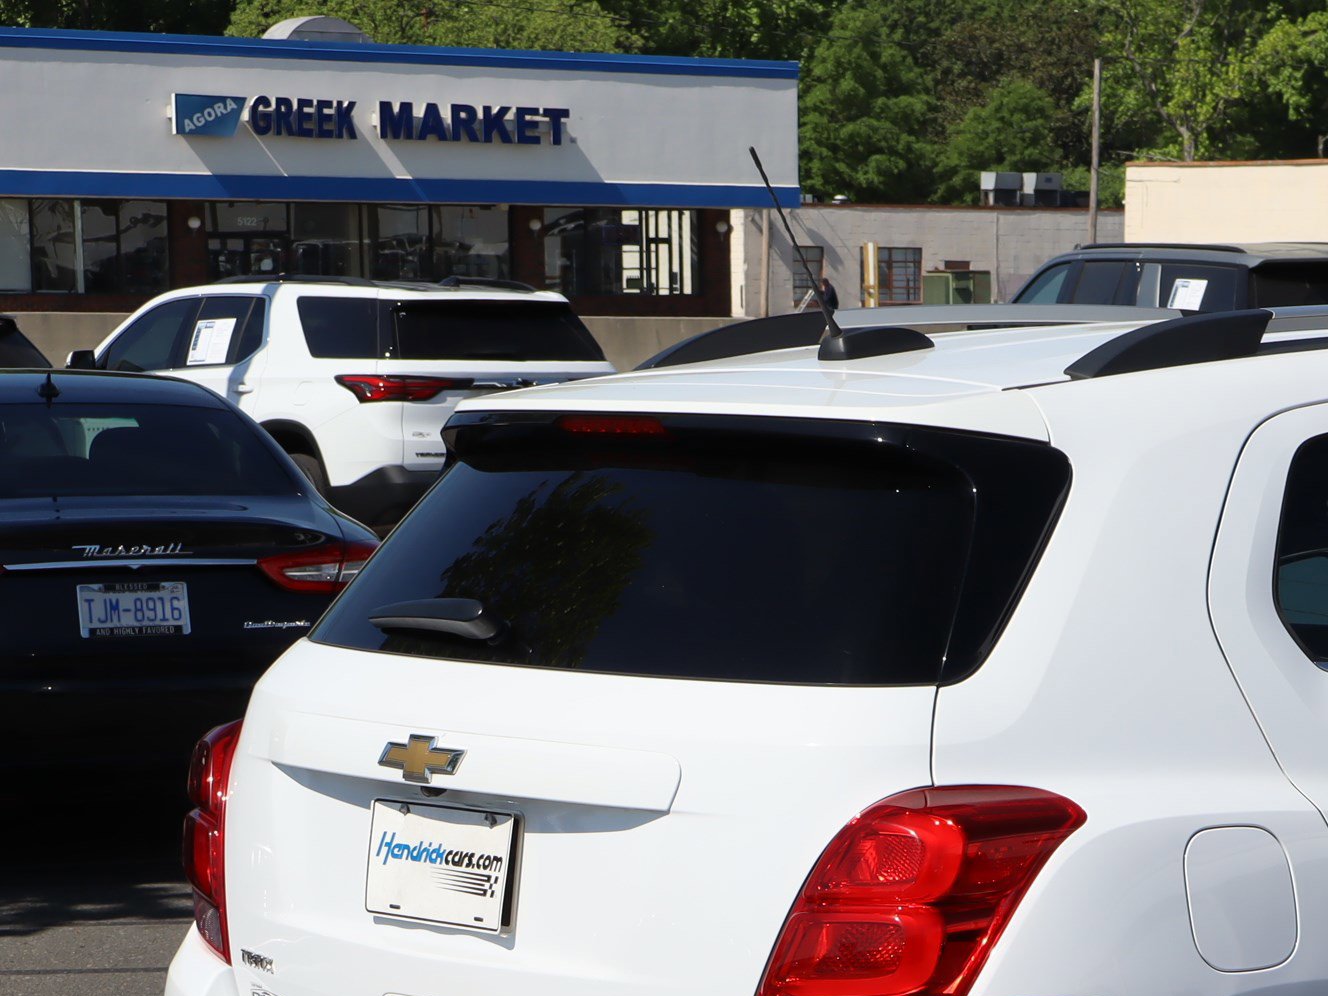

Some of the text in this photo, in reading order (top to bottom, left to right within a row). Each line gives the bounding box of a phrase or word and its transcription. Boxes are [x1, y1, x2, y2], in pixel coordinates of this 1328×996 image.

[184, 95, 570, 146] AGORA GREEK MARKET
[84, 596, 182, 624] TJM-8916
